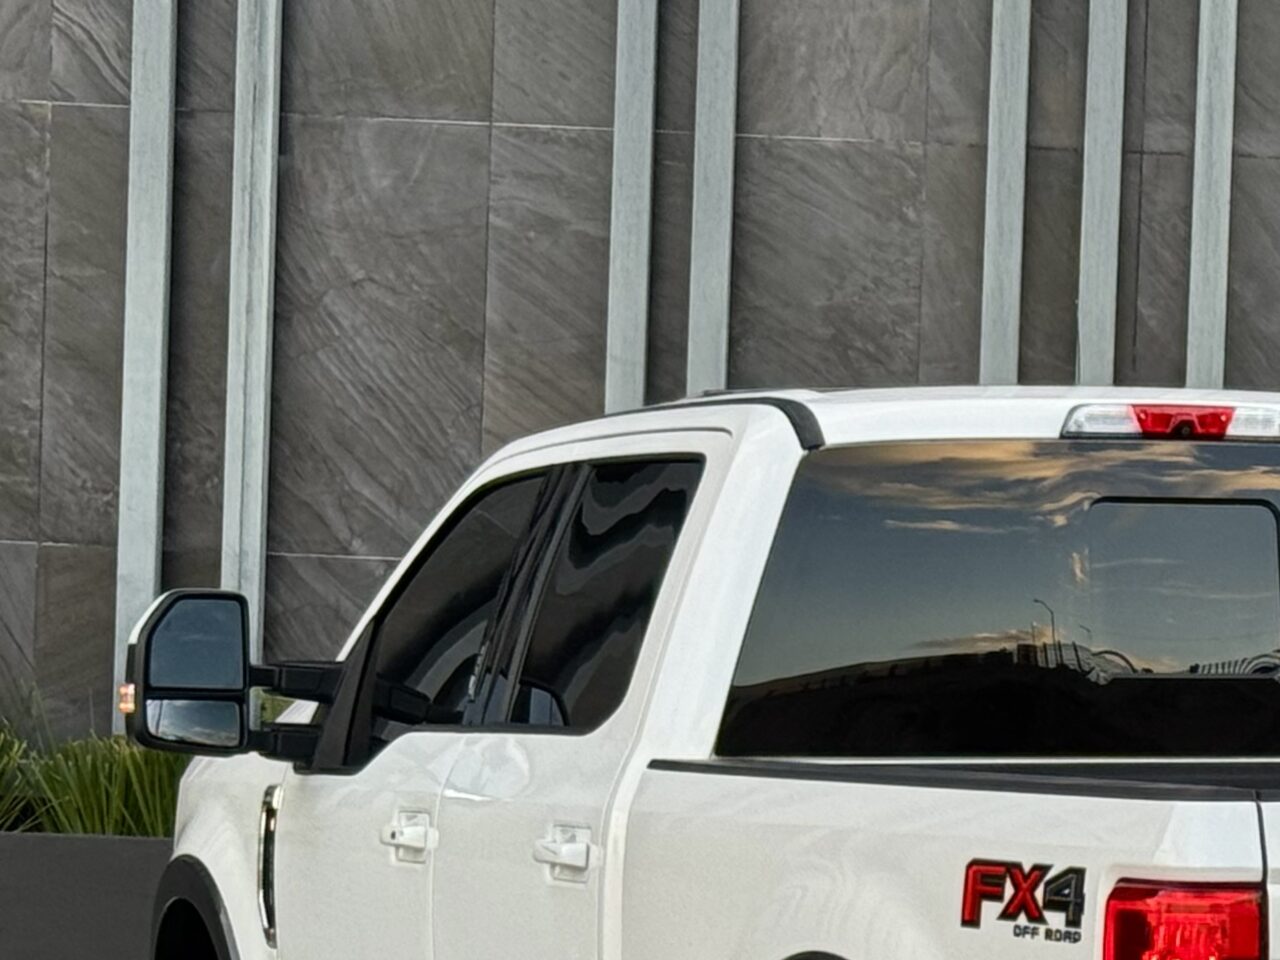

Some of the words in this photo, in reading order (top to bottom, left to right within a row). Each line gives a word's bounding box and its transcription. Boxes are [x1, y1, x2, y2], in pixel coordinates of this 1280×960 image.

[960, 857, 1086, 929] FX4
[1013, 924, 1039, 939] OFF
[1044, 928, 1082, 944] ROAD
